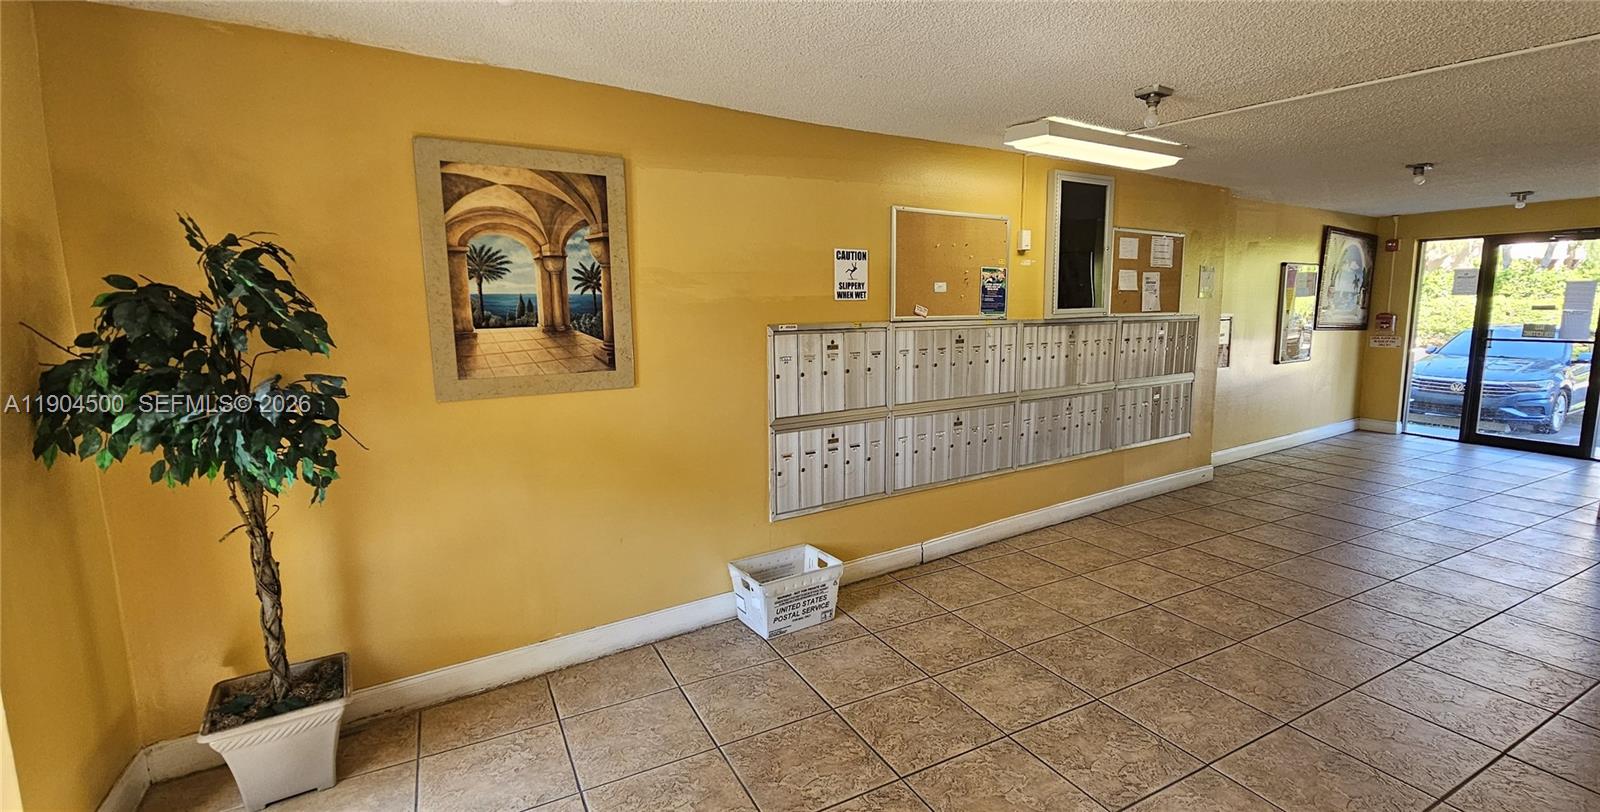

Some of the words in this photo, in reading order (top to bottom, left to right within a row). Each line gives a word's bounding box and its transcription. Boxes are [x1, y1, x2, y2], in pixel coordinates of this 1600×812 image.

[836, 250, 867, 261] CAUTION
[838, 281, 865, 290] SLIPPERY
[836, 291, 854, 299] WHEN
[854, 291, 867, 299] WET
[776, 602, 801, 615] UNITED
[802, 594, 828, 608] STATES
[773, 610, 800, 624] POSTAL
[801, 601, 830, 615] SERVICE
